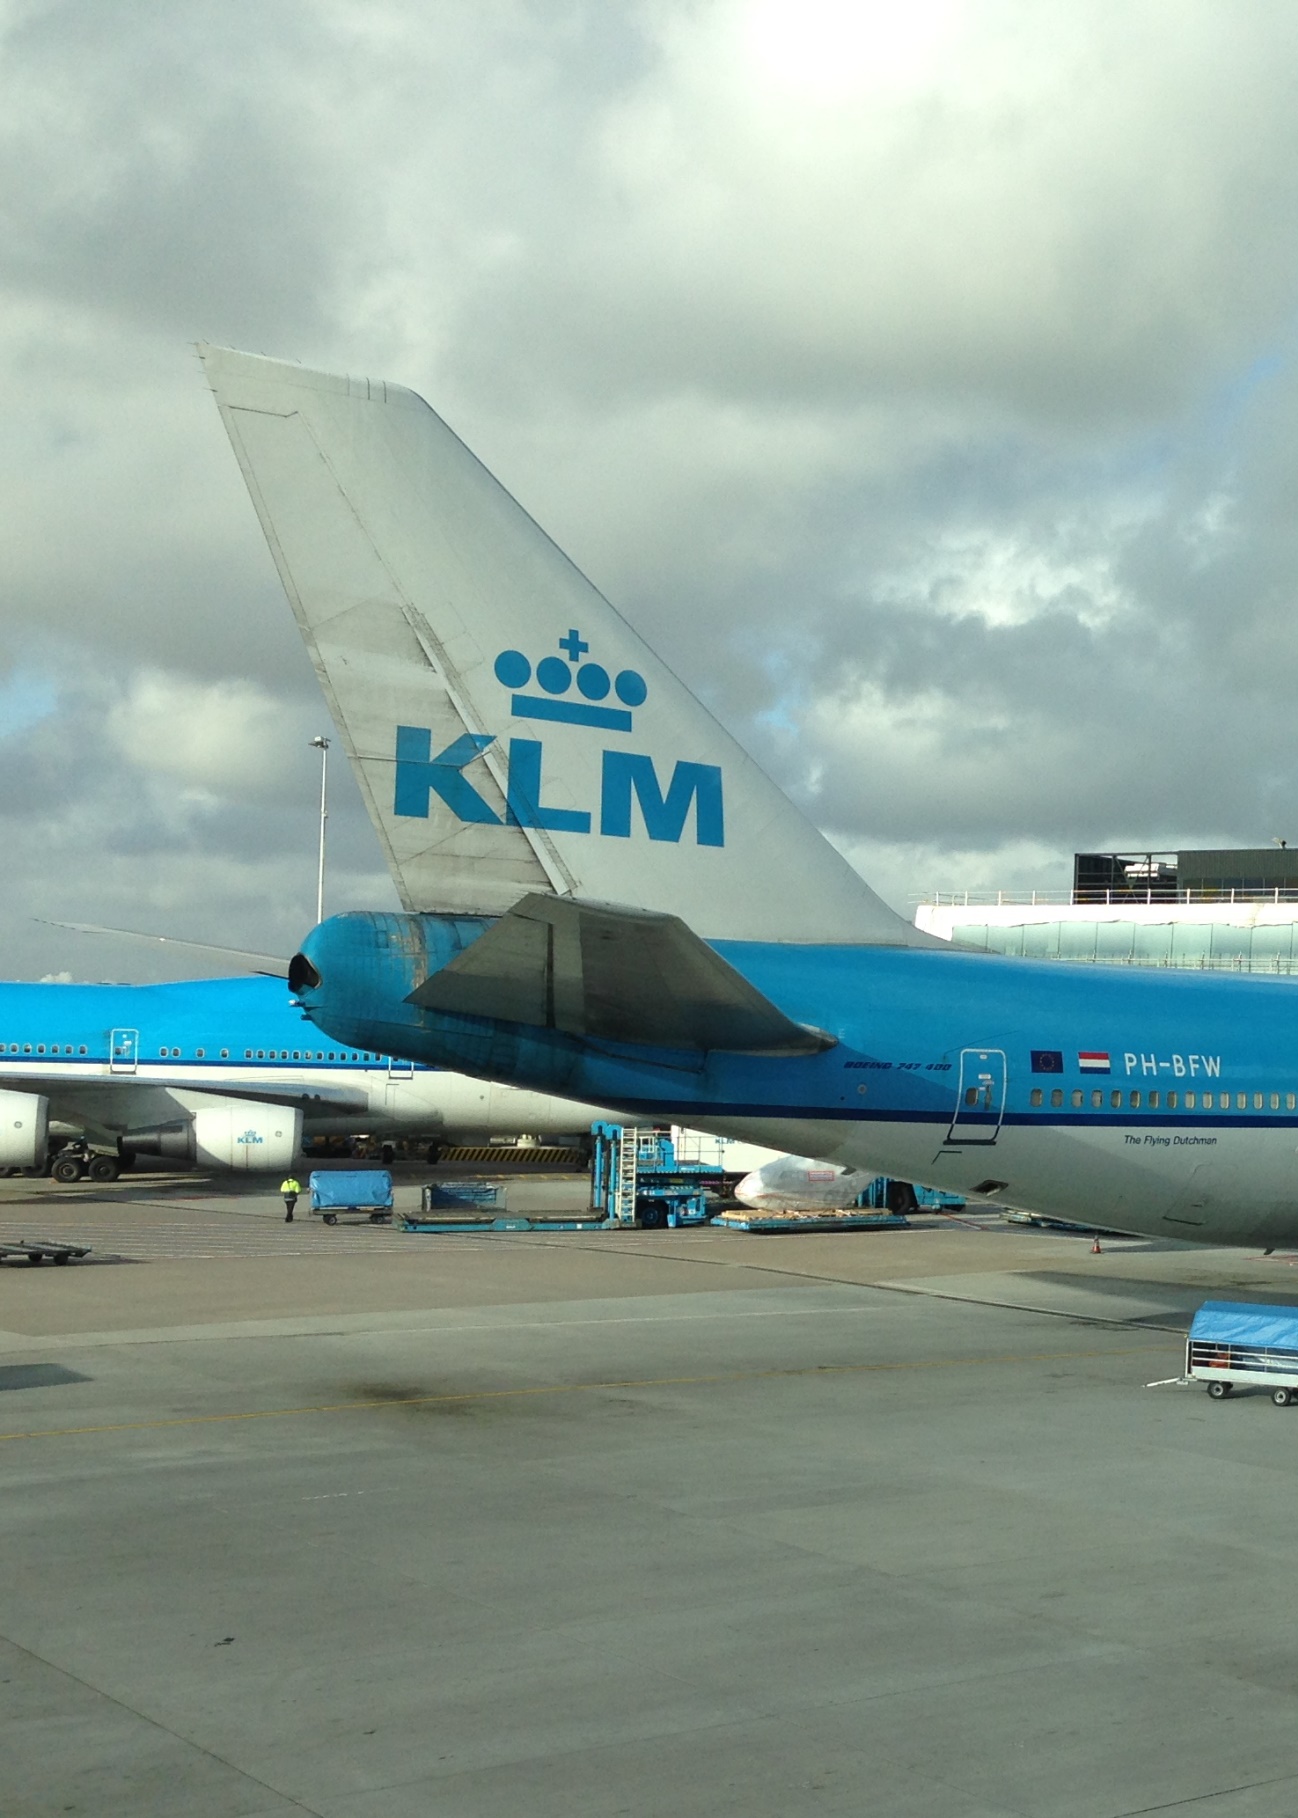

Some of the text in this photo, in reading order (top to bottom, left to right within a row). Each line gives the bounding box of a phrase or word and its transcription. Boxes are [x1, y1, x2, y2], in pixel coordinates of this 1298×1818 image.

[394, 724, 725, 848] KLM
[1124, 1053, 1220, 1077] PH-BFW
[237, 1136, 263, 1144] KLM
[1124, 1135, 1217, 1147] The Flying Dutchman
